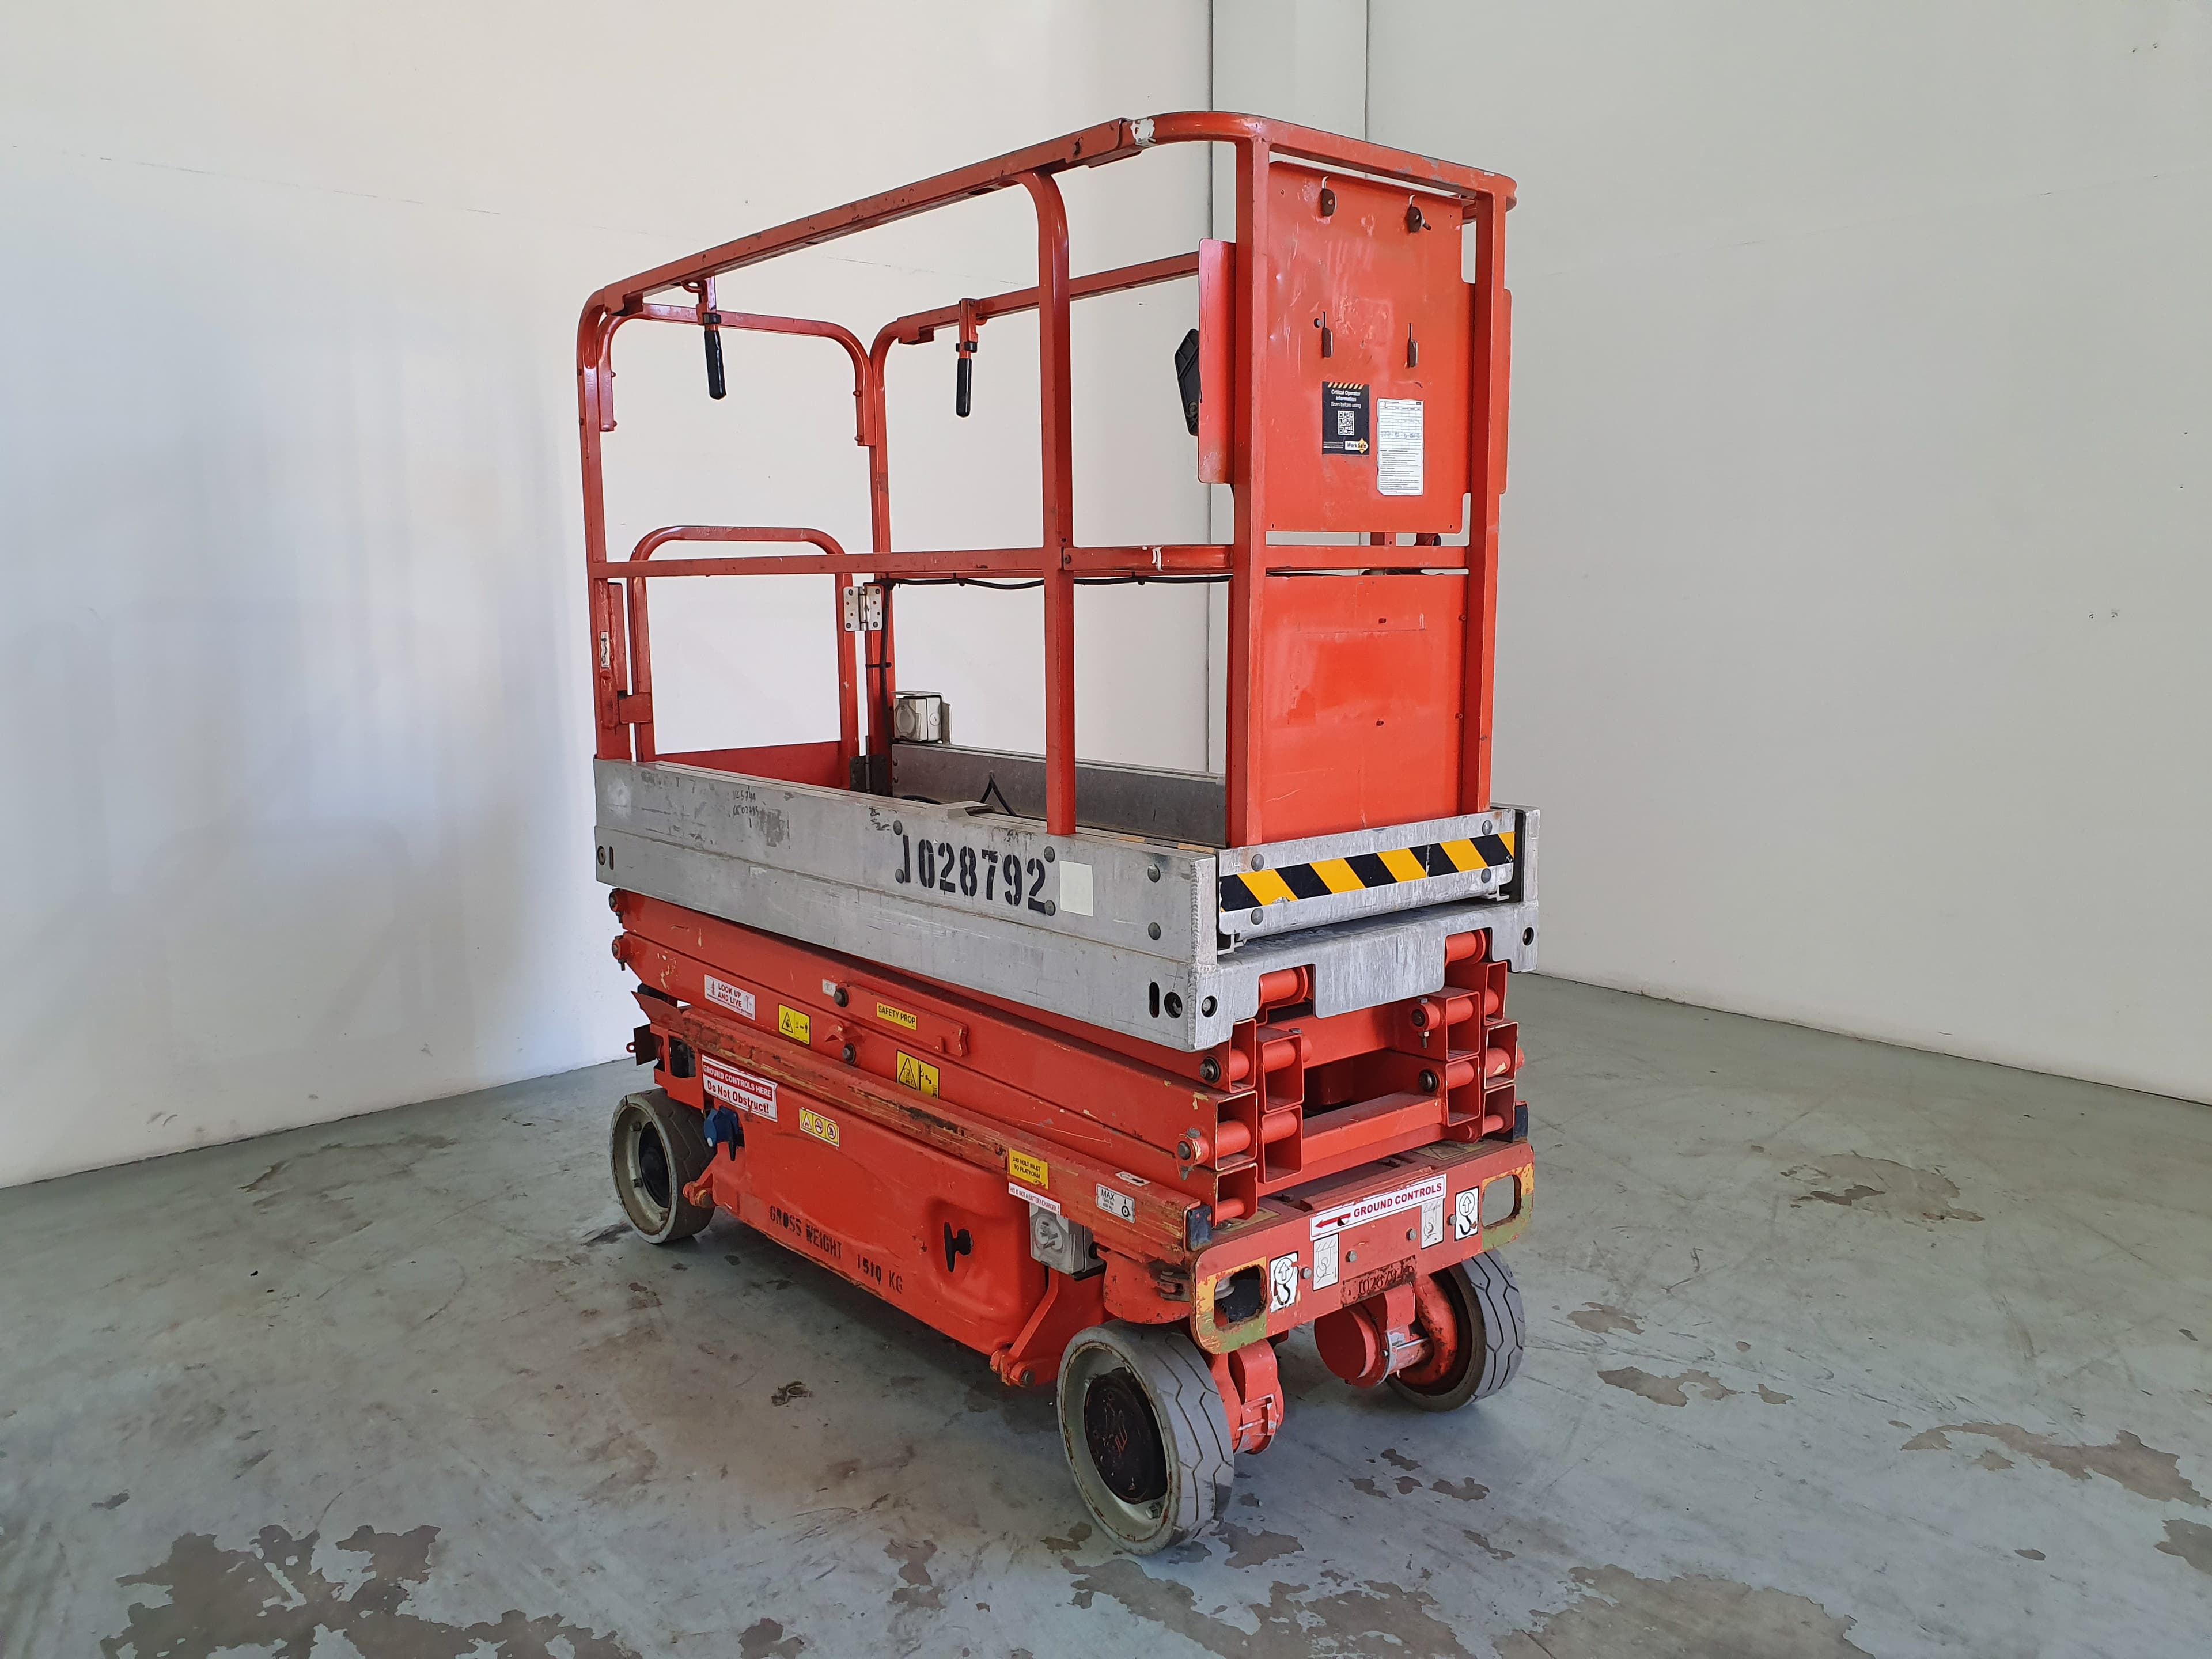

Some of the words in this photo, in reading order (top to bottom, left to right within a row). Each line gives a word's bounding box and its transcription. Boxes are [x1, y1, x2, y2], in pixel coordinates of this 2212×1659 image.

[903, 834, 1048, 914] 1028792
[718, 983, 733, 995] LOOK
[734, 990, 741, 998] UP
[718, 992, 729, 1001] AND
[730, 997, 742, 1007] LIVE
[878, 1005, 899, 1018] SAFETY
[900, 1013, 915, 1024] PROP
[703, 1065, 724, 1079] GROUND
[725, 1074, 755, 1091] CONTROLS
[755, 1085, 771, 1097] HERE
[707, 1080, 716, 1092] Do
[718, 1085, 730, 1100] Not
[732, 1091, 770, 1113] Obstruct!
[1020, 1167, 1040, 1179] PLATFORM
[1028, 1194, 1041, 1205] BATTERY
[1101, 1189, 1115, 1201] MAX
[1354, 1198, 1393, 1217] GROUND
[1395, 1183, 1442, 1205] CONTROLS
[770, 1205, 802, 1237] GROSS
[805, 1224, 842, 1260] WEIGHT
[889, 1270, 903, 1294] KG
